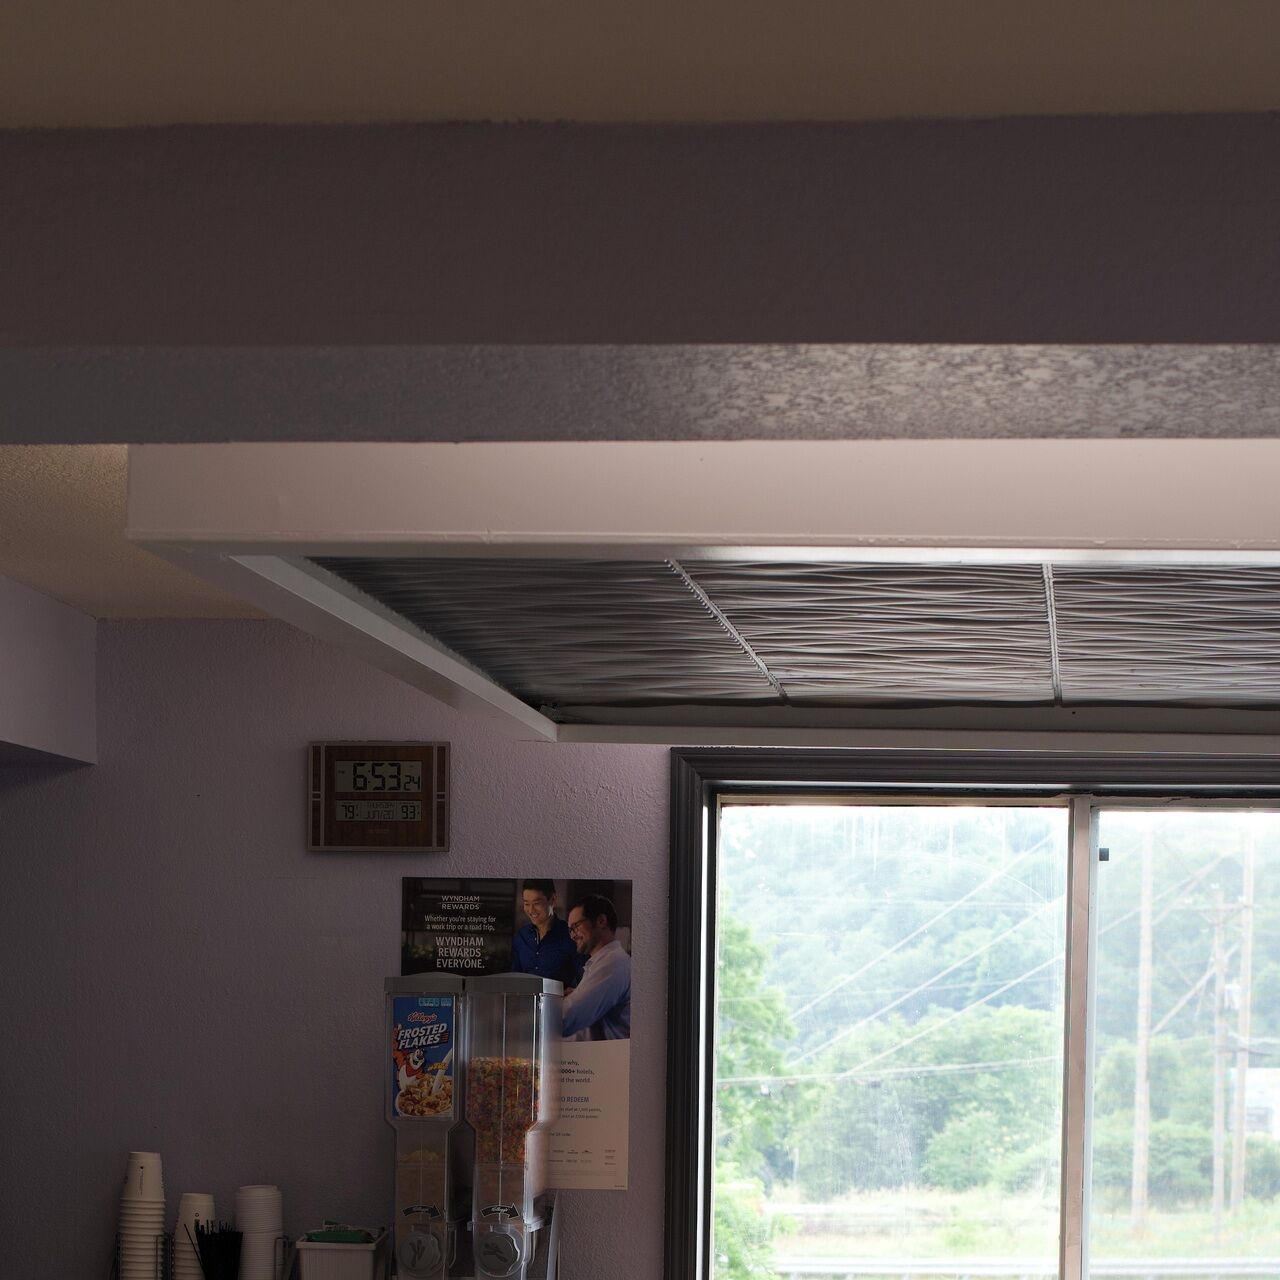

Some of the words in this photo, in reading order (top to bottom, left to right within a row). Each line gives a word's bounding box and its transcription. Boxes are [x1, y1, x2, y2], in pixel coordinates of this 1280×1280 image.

[353, 762, 401, 790] 6:53
[449, 915, 466, 924] you're
[467, 915, 487, 924] staying
[446, 924, 456, 932] trip
[436, 936, 484, 946] WYNDHAM
[438, 948, 482, 958] REWARDS
[436, 958, 486, 968] EVERYONE.
[408, 1010, 438, 1024] Kellogg's
[398, 1022, 448, 1040] FROSTED
[398, 1033, 440, 1050] FLAKES
